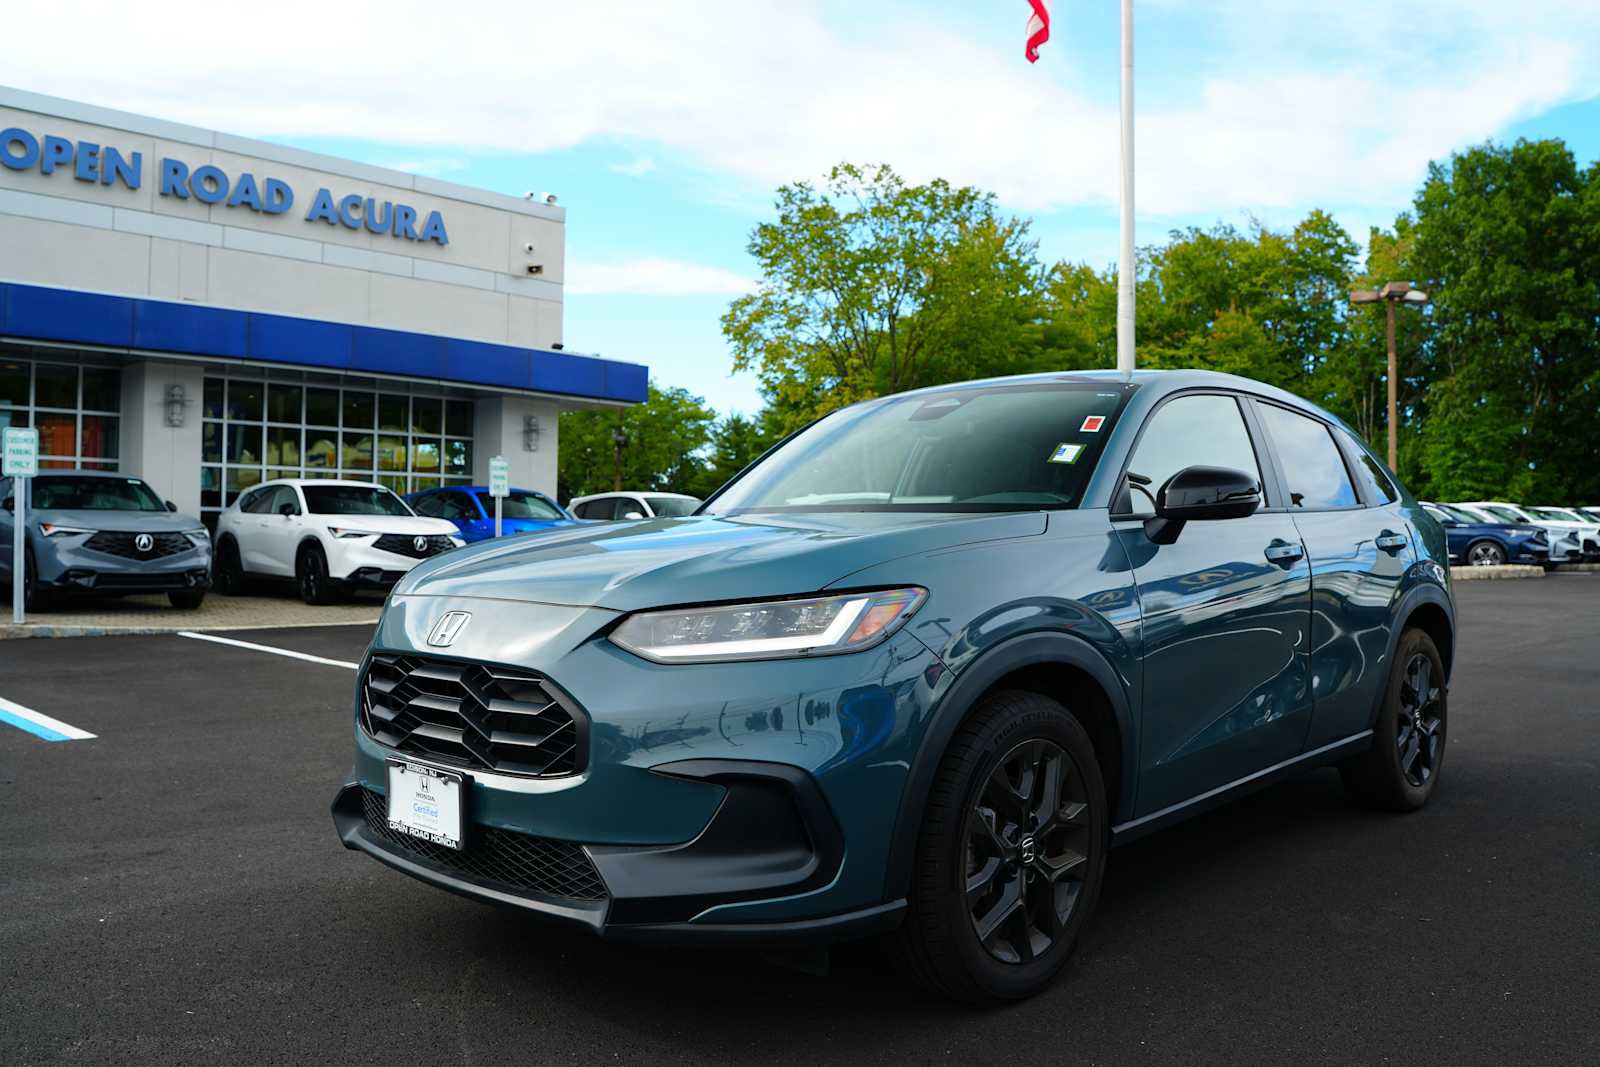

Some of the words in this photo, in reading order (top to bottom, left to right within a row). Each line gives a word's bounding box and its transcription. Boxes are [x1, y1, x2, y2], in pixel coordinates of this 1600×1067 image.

[0, 127, 142, 190] OPEN
[160, 157, 294, 215] ROAD
[304, 187, 449, 246] ACURA
[416, 792, 435, 801] HONDA
[389, 821, 408, 835] OPEN
[409, 828, 430, 840] ROAD
[430, 834, 457, 849] HONDA
